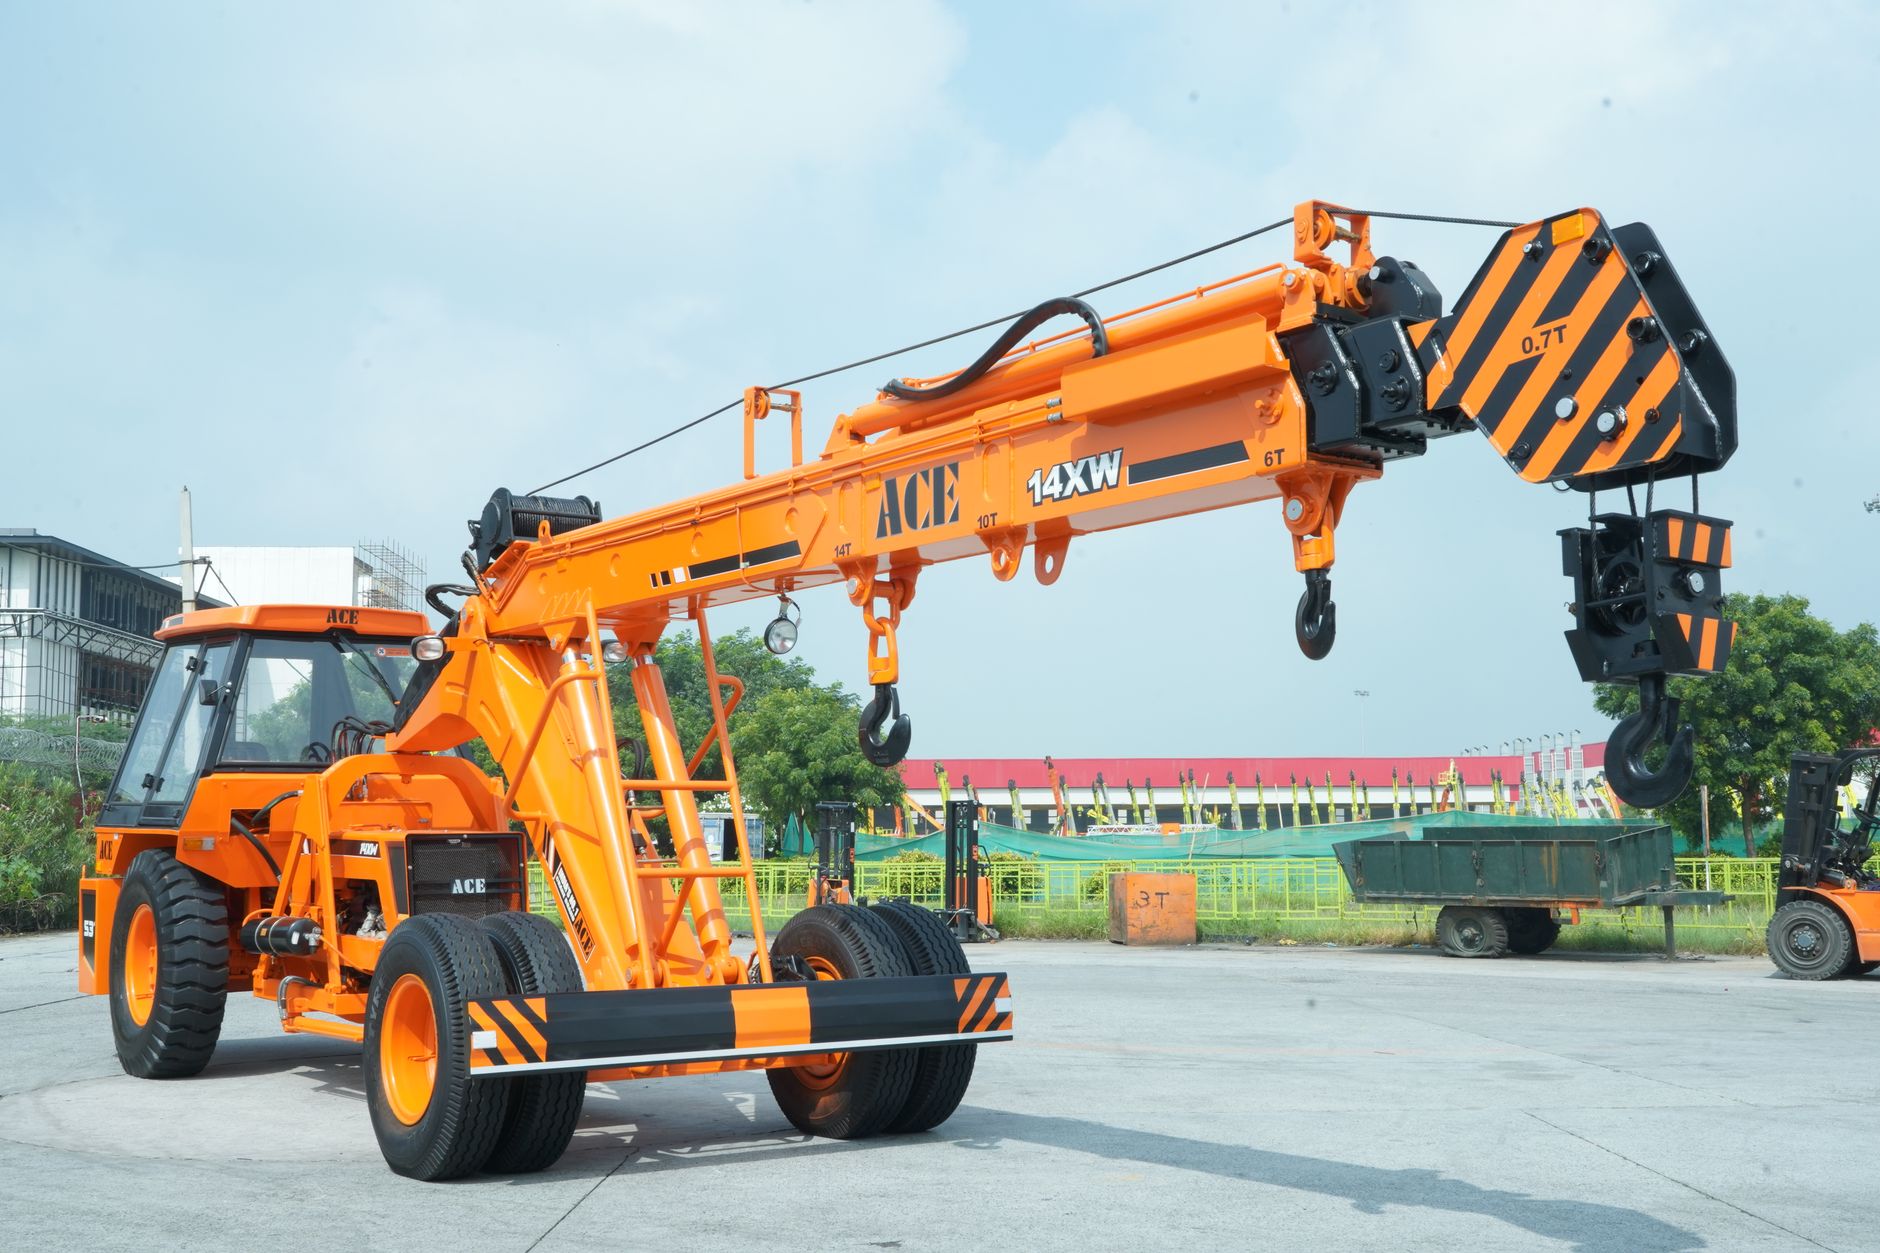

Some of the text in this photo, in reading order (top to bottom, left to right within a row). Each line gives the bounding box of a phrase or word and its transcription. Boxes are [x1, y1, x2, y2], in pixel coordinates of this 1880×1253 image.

[1521, 324, 1567, 354] 0.7T
[1264, 448, 1285, 467] 6T
[1027, 448, 1123, 506] 14XW
[876, 462, 959, 539] ACE
[977, 512, 998, 529] 10T
[834, 543, 851, 558] 14T
[326, 608, 359, 624] ACE
[99, 840, 113, 860] ACE
[452, 878, 486, 894] ACE
